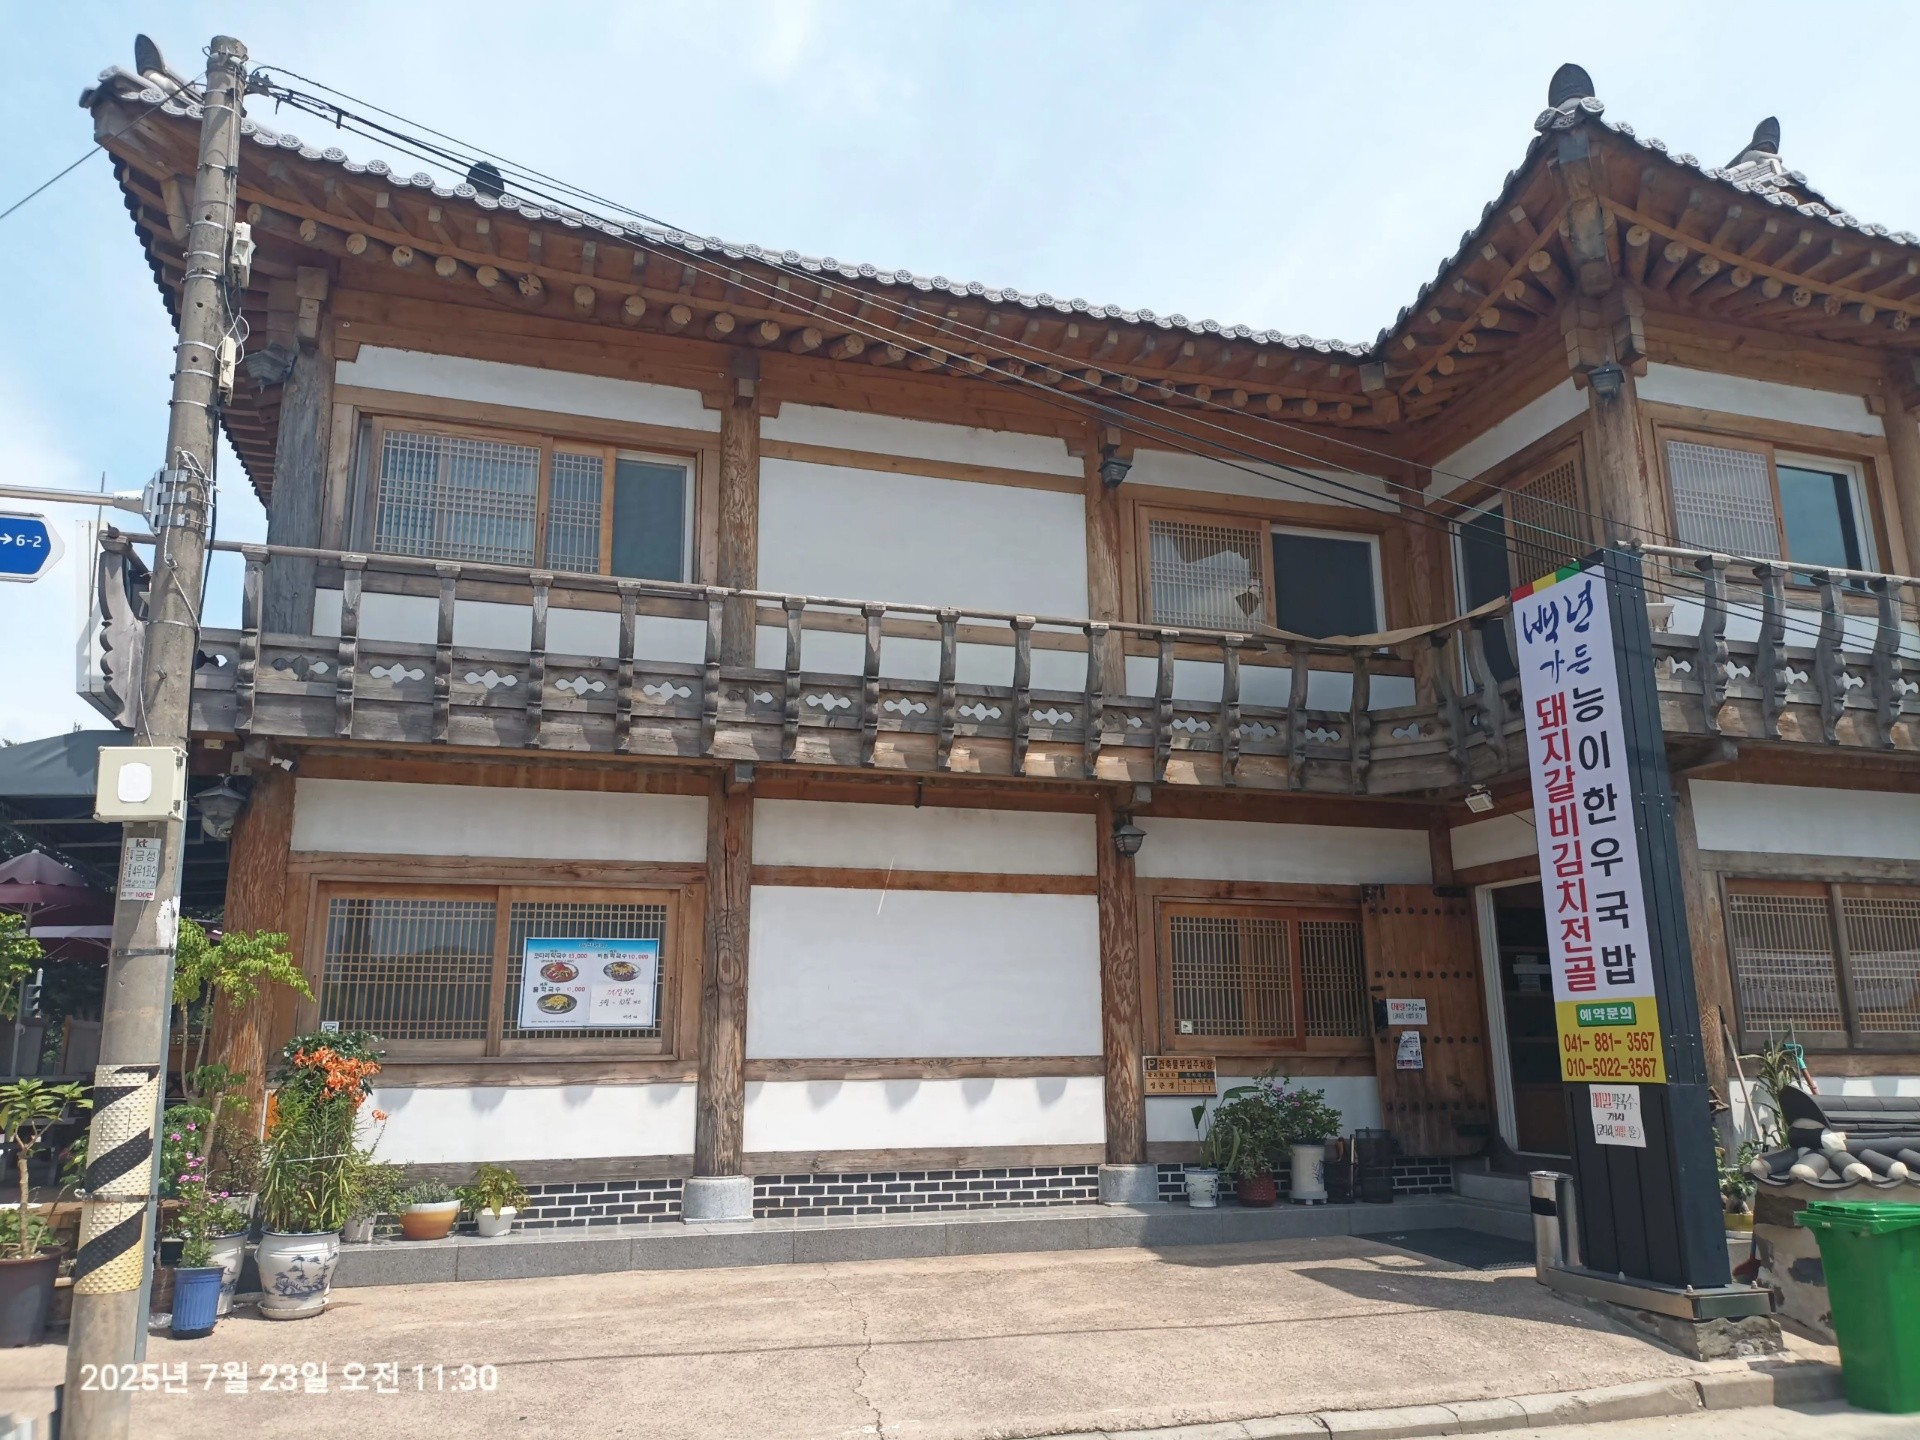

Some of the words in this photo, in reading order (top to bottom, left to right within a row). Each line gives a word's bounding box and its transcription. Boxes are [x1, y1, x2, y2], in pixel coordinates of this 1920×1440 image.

[16, 534, 42, 548] 6-2
[1522, 579, 1594, 644] 백년
[1539, 643, 1593, 684] 가든
[135, 838, 149, 848] kt
[135, 850, 156, 862] 금성
[1579, 1006, 1633, 1022] 예약문의
[1626, 1031, 1656, 1052] 3567
[1147, 1059, 1156, 1070] P
[1566, 1057, 1657, 1078] 010-5022-3567
